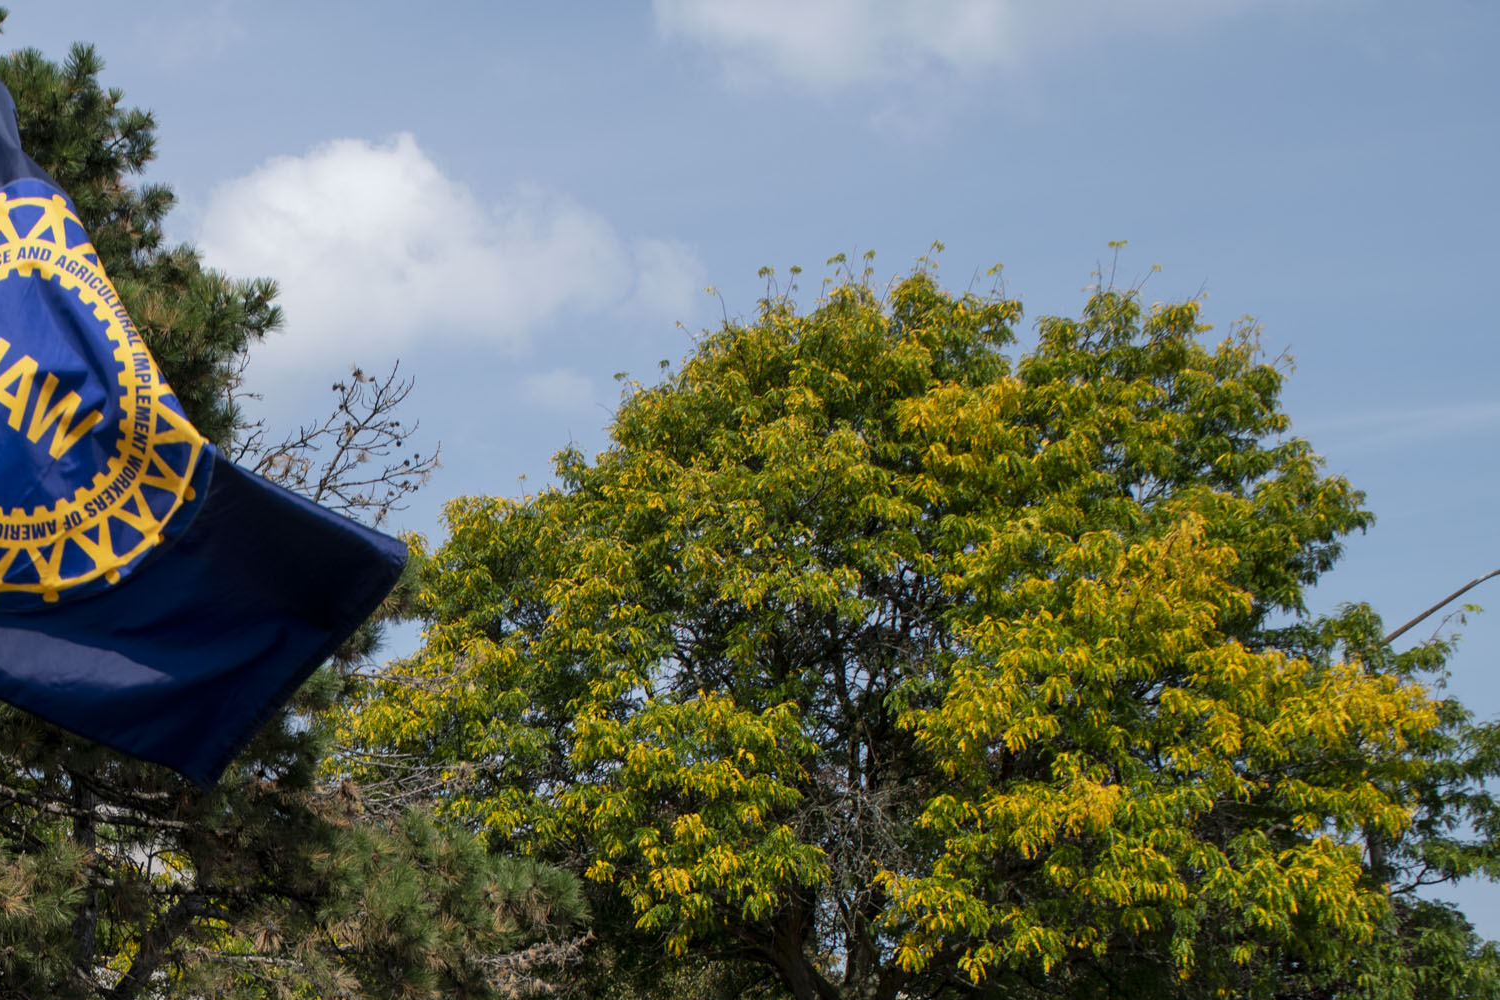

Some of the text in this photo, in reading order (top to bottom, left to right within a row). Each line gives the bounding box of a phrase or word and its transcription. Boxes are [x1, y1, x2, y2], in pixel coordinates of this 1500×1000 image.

[17, 246, 51, 262] AND
[55, 255, 137, 346] AGRICULTURAL
[132, 351, 152, 455] IMPLEMENT
[83, 455, 144, 518] WORKERS
[63, 510, 81, 531] OF
